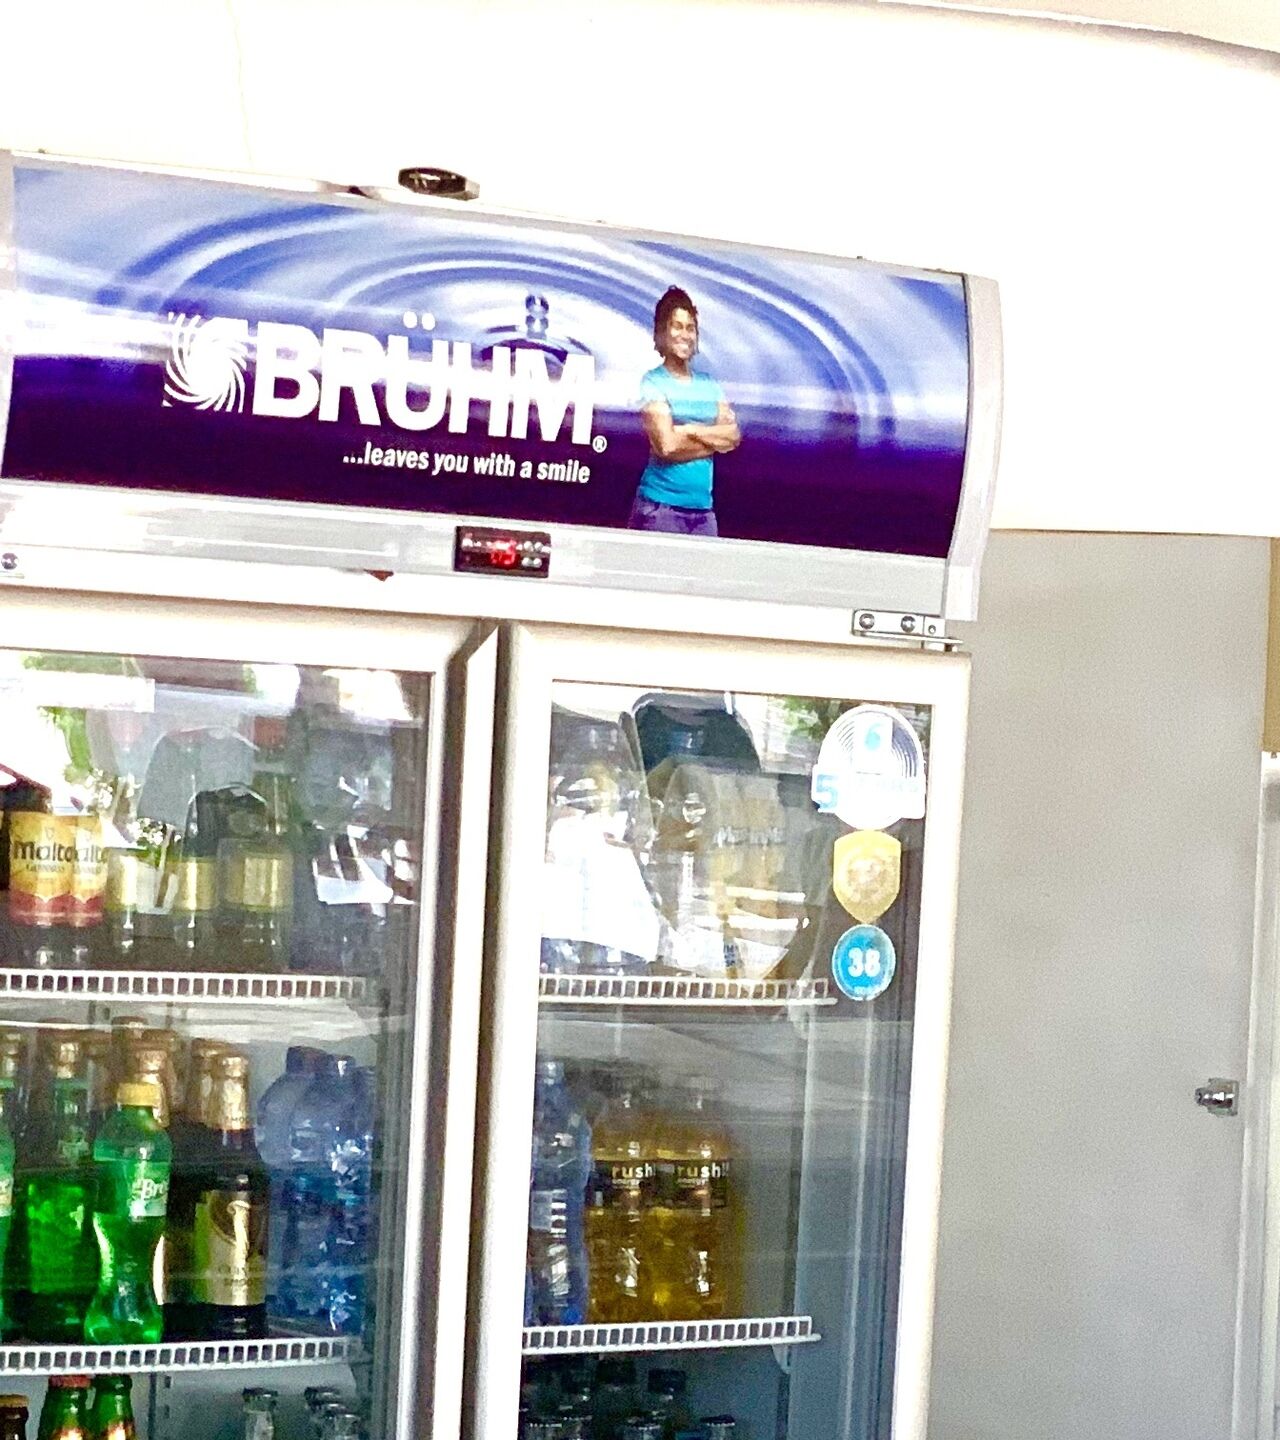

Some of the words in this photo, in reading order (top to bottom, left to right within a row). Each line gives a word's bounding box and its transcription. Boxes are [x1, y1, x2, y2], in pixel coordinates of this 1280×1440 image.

[343, 441, 430, 470] ...leaves
[432, 453, 468, 476] you
[473, 452, 515, 478] with
[519, 461, 534, 479] a
[537, 458, 591, 484] smile
[848, 947, 881, 978] 38
